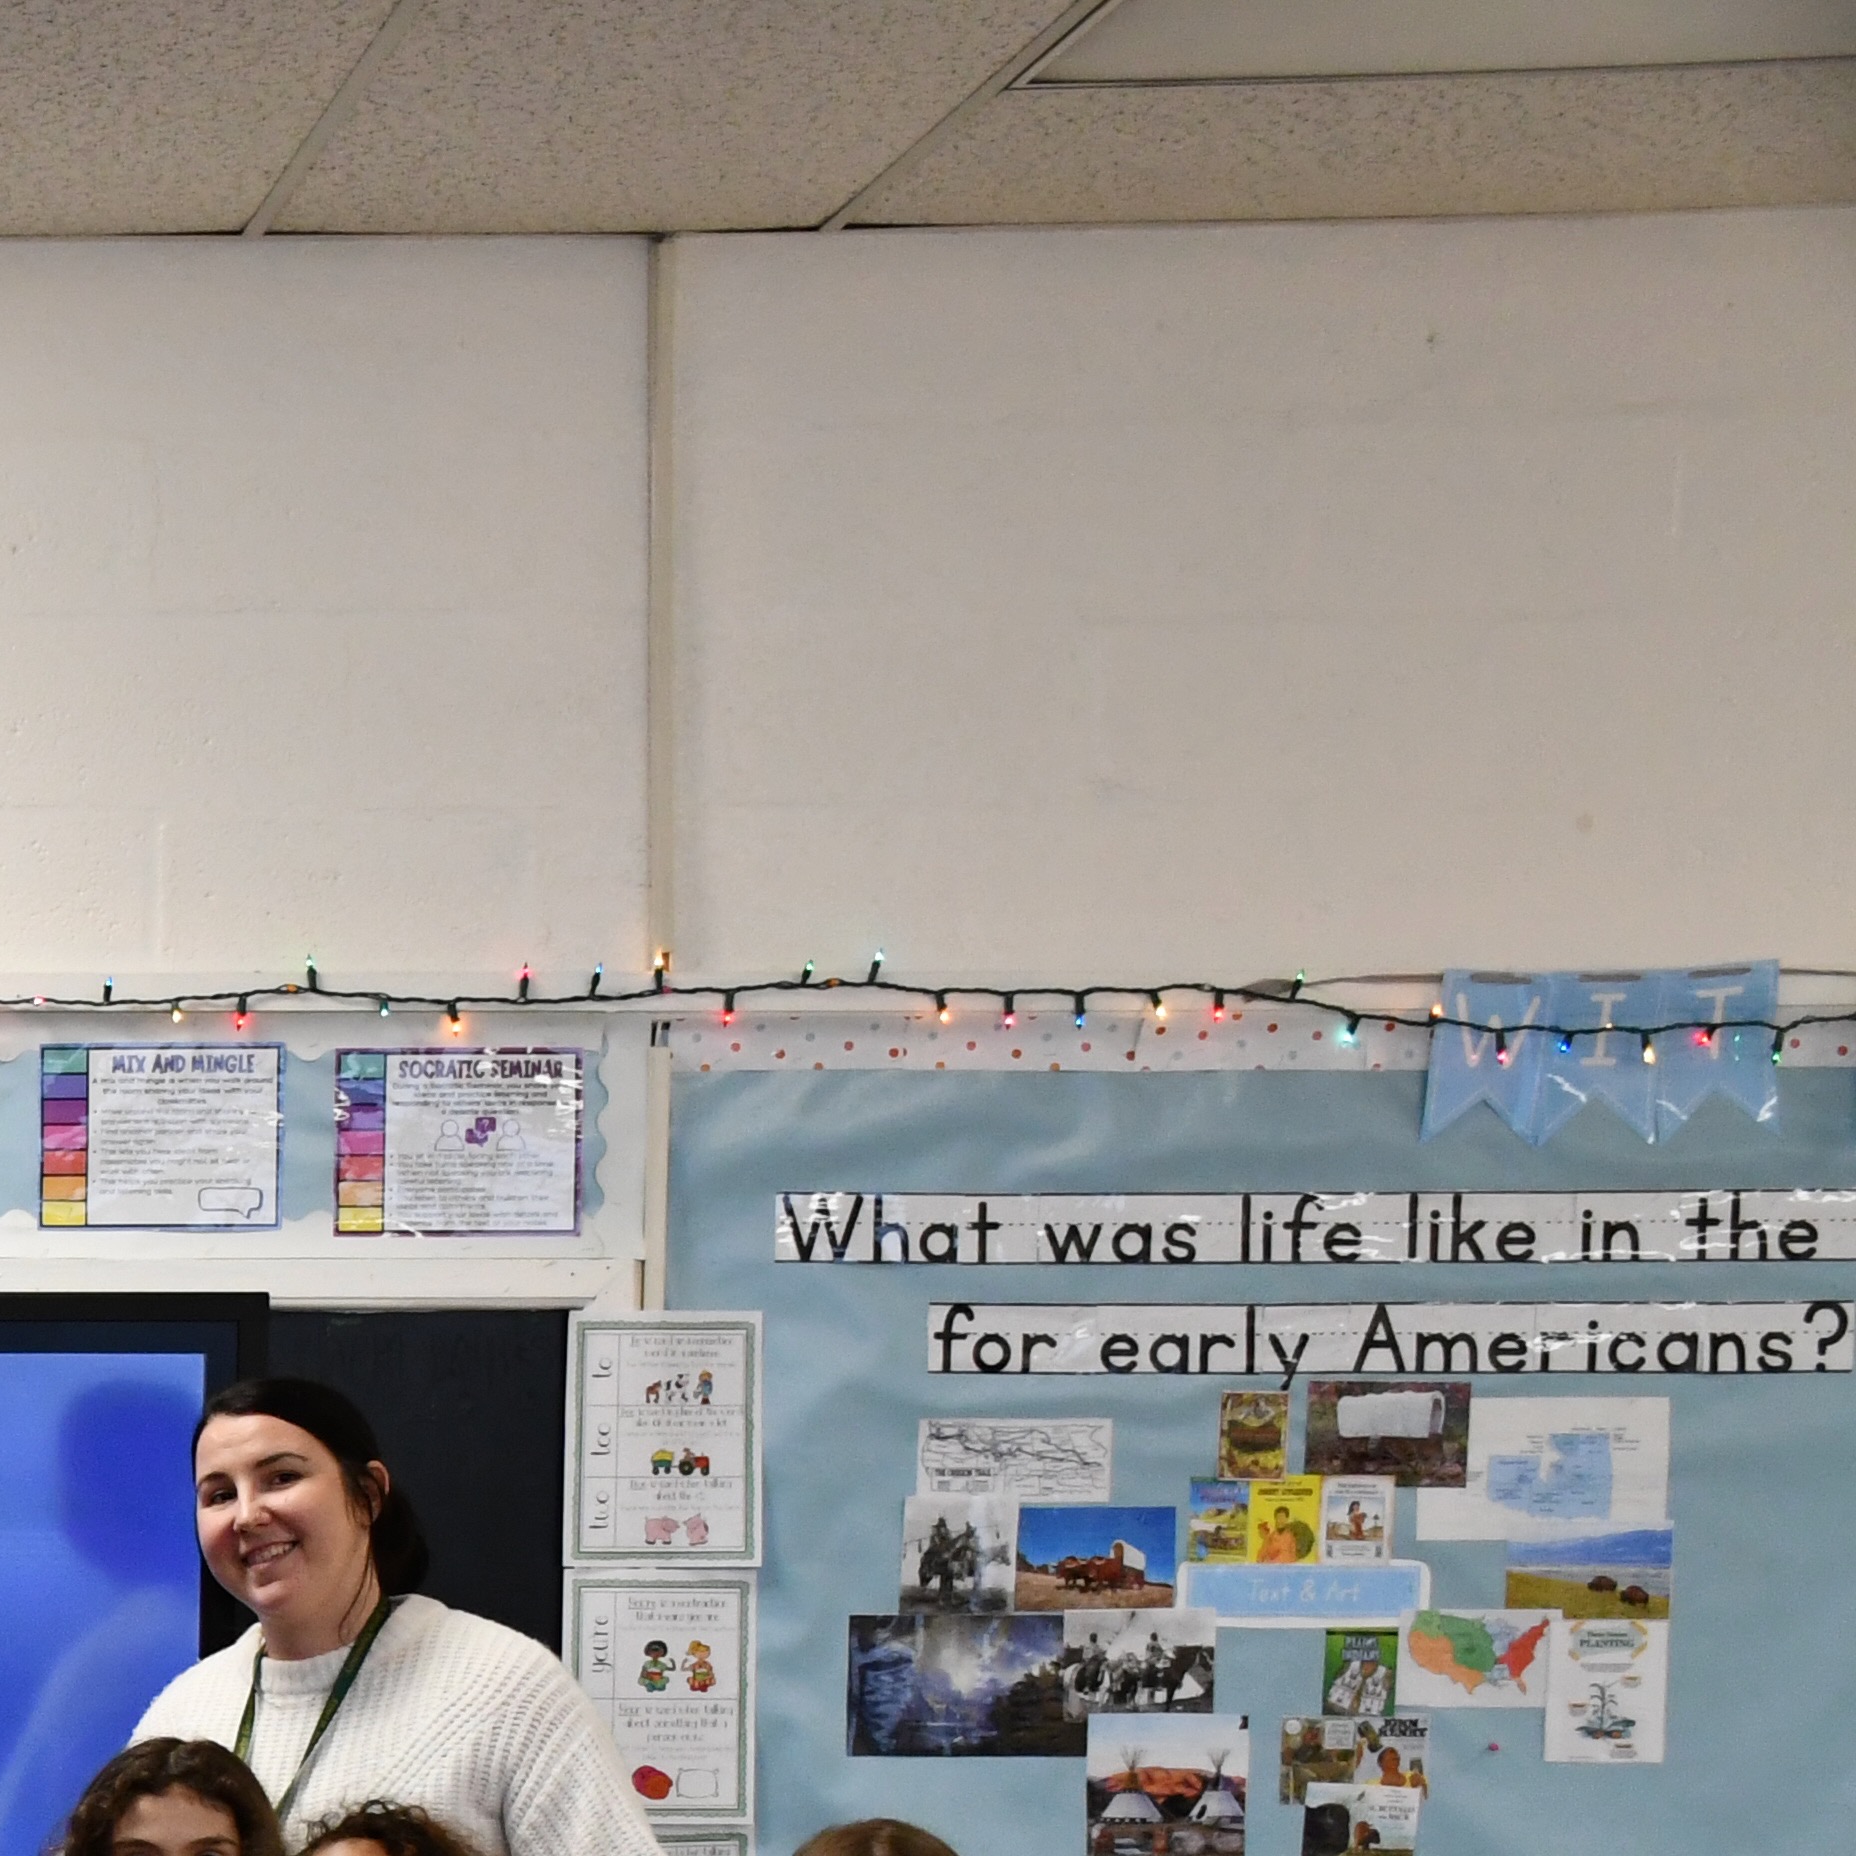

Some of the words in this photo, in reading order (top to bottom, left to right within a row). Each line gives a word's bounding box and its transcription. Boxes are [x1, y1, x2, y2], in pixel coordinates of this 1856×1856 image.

[112, 1055, 145, 1073] MIX
[151, 1054, 186, 1074] AND
[191, 1054, 255, 1073] MINGLE
[399, 1059, 486, 1079] SOCRATIC
[491, 1060, 563, 1078] SEMINAR
[782, 1193, 1000, 1263] What
[1043, 1218, 1196, 1263] was
[1239, 1192, 1363, 1263] life
[1406, 1192, 1537, 1262] like
[1578, 1207, 1640, 1262] in
[1686, 1192, 1819, 1261] the
[932, 1304, 1056, 1373] for
[1100, 1304, 1308, 1393] early
[1351, 1301, 1850, 1373] Americans?
